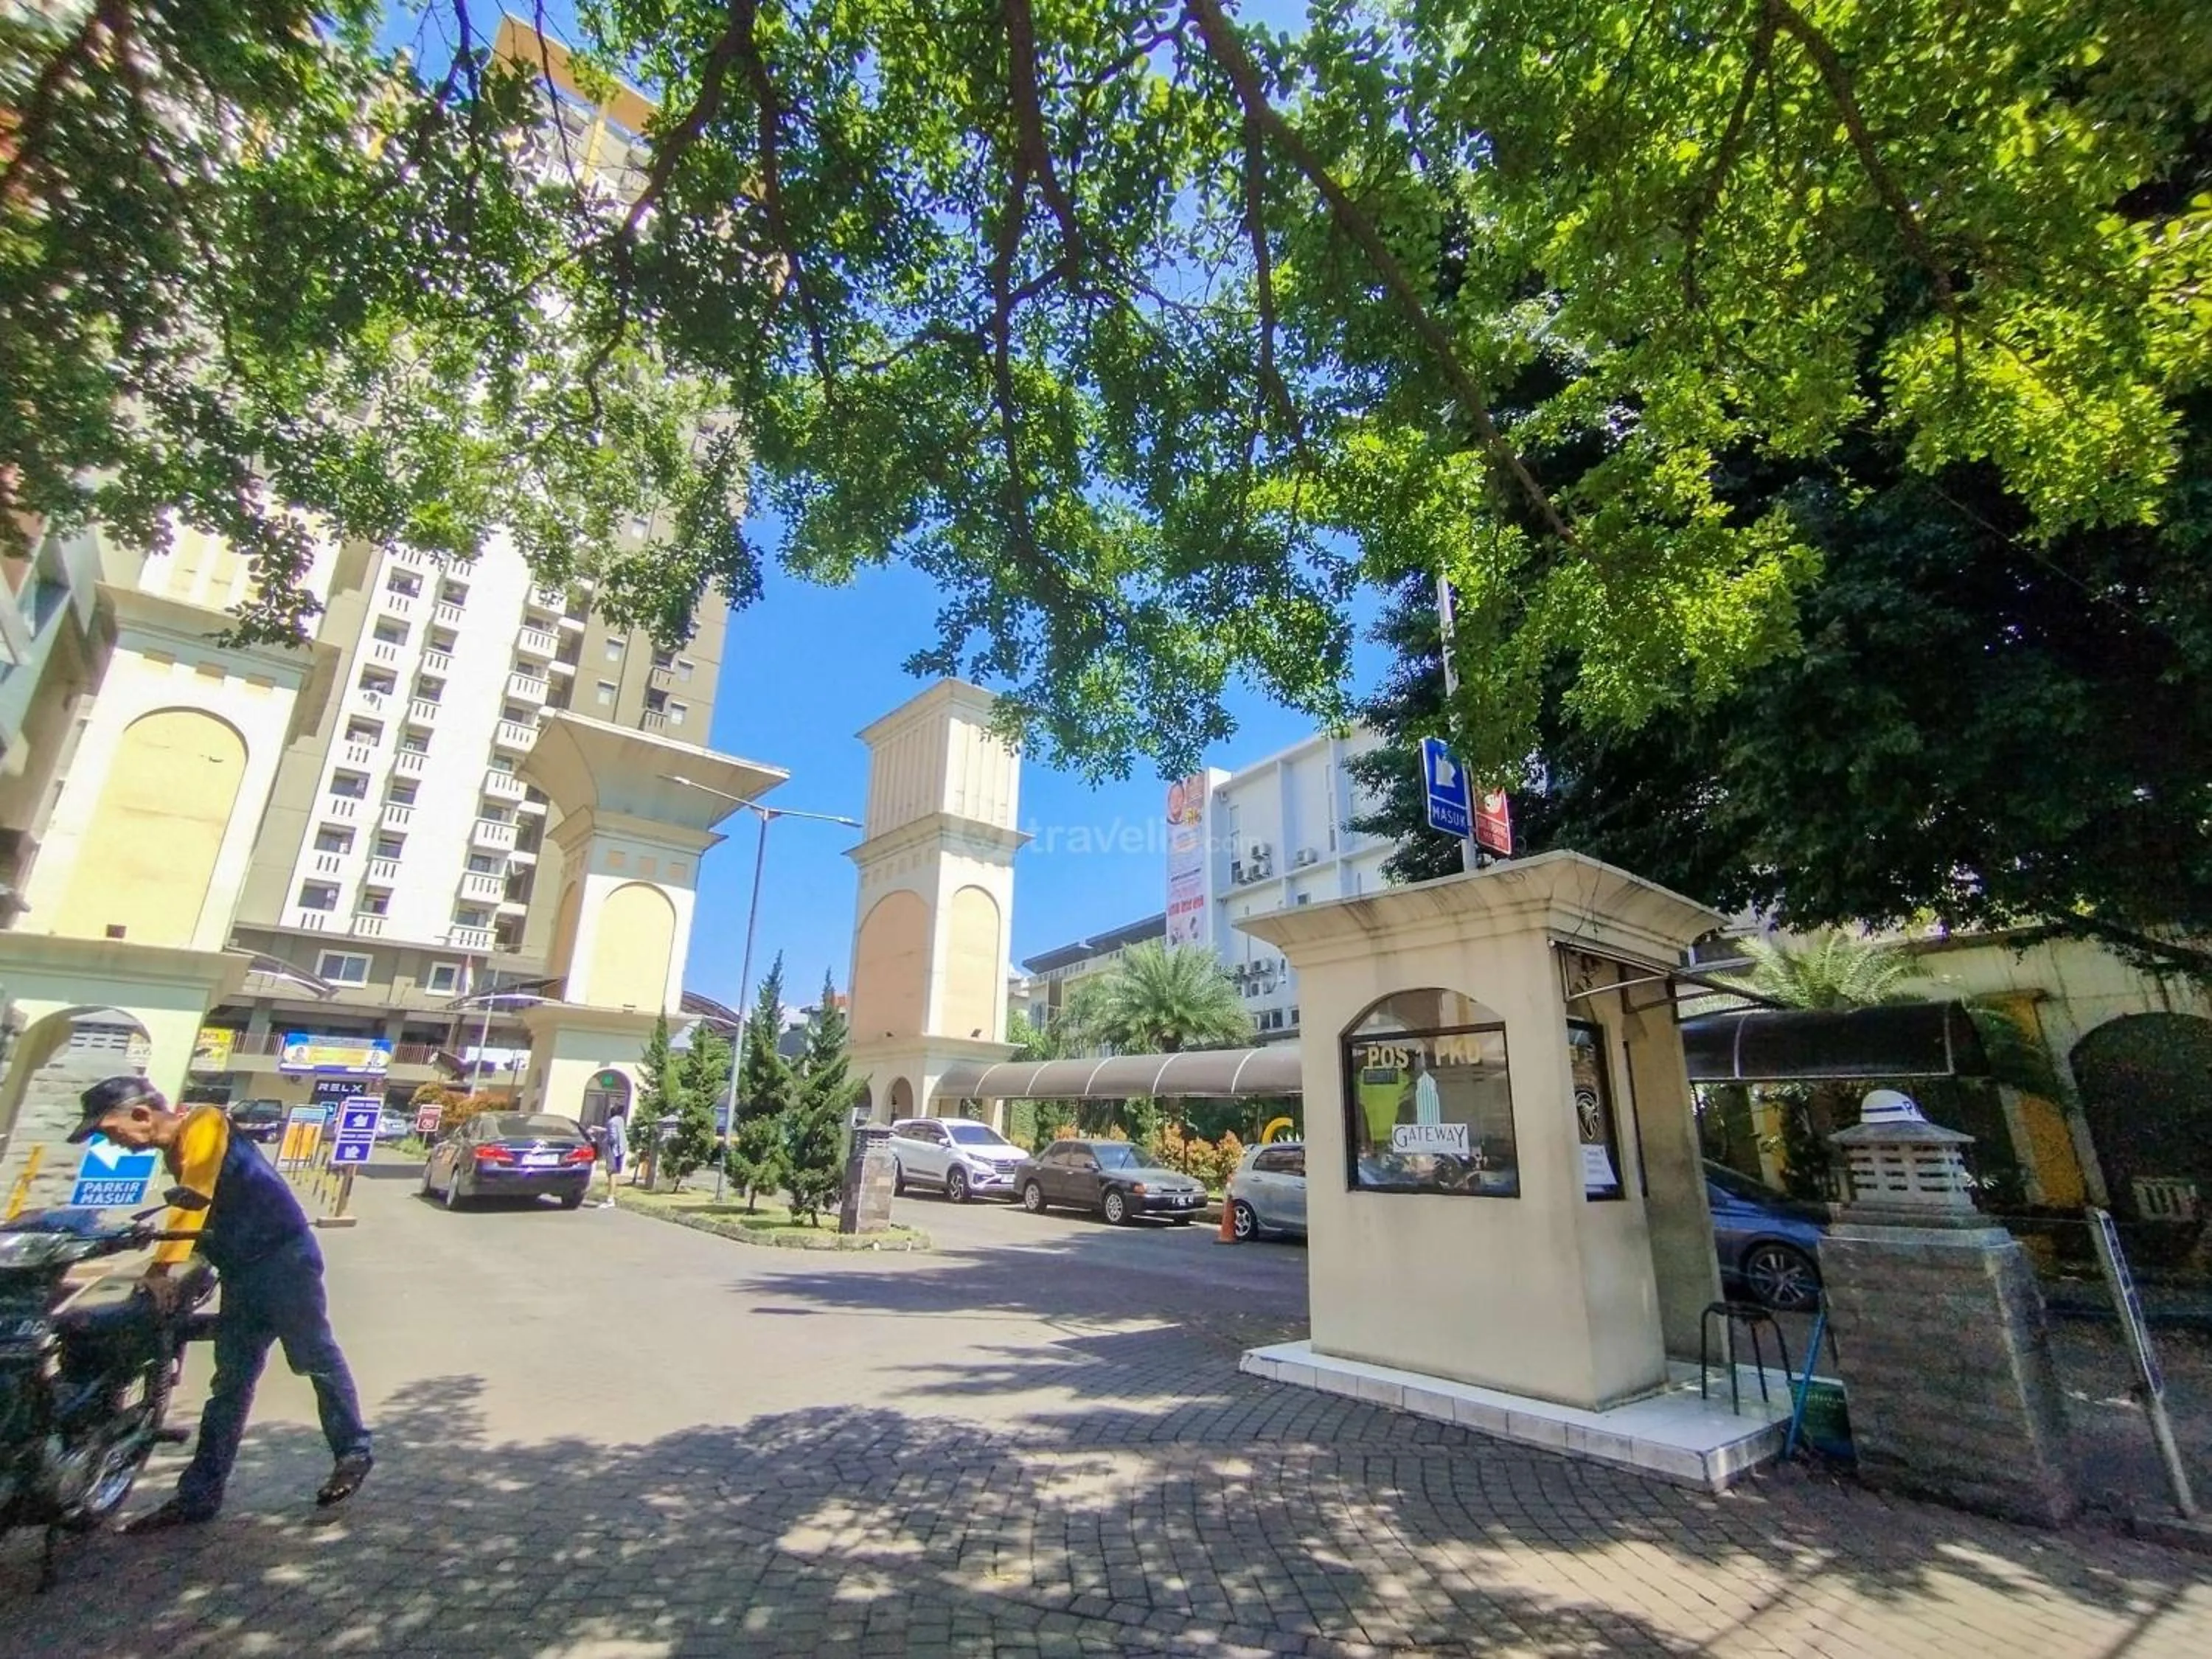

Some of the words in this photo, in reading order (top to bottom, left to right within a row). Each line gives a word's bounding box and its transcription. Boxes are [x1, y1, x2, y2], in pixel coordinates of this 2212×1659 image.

[1433, 805, 1467, 828] MASUK
[1367, 1046, 1409, 1069] POS
[318, 1082, 363, 1093] RELX
[1394, 1125, 1465, 1148] GATEWAY
[83, 1182, 140, 1192] PARKIR
[79, 1192, 136, 1204] MASUK
